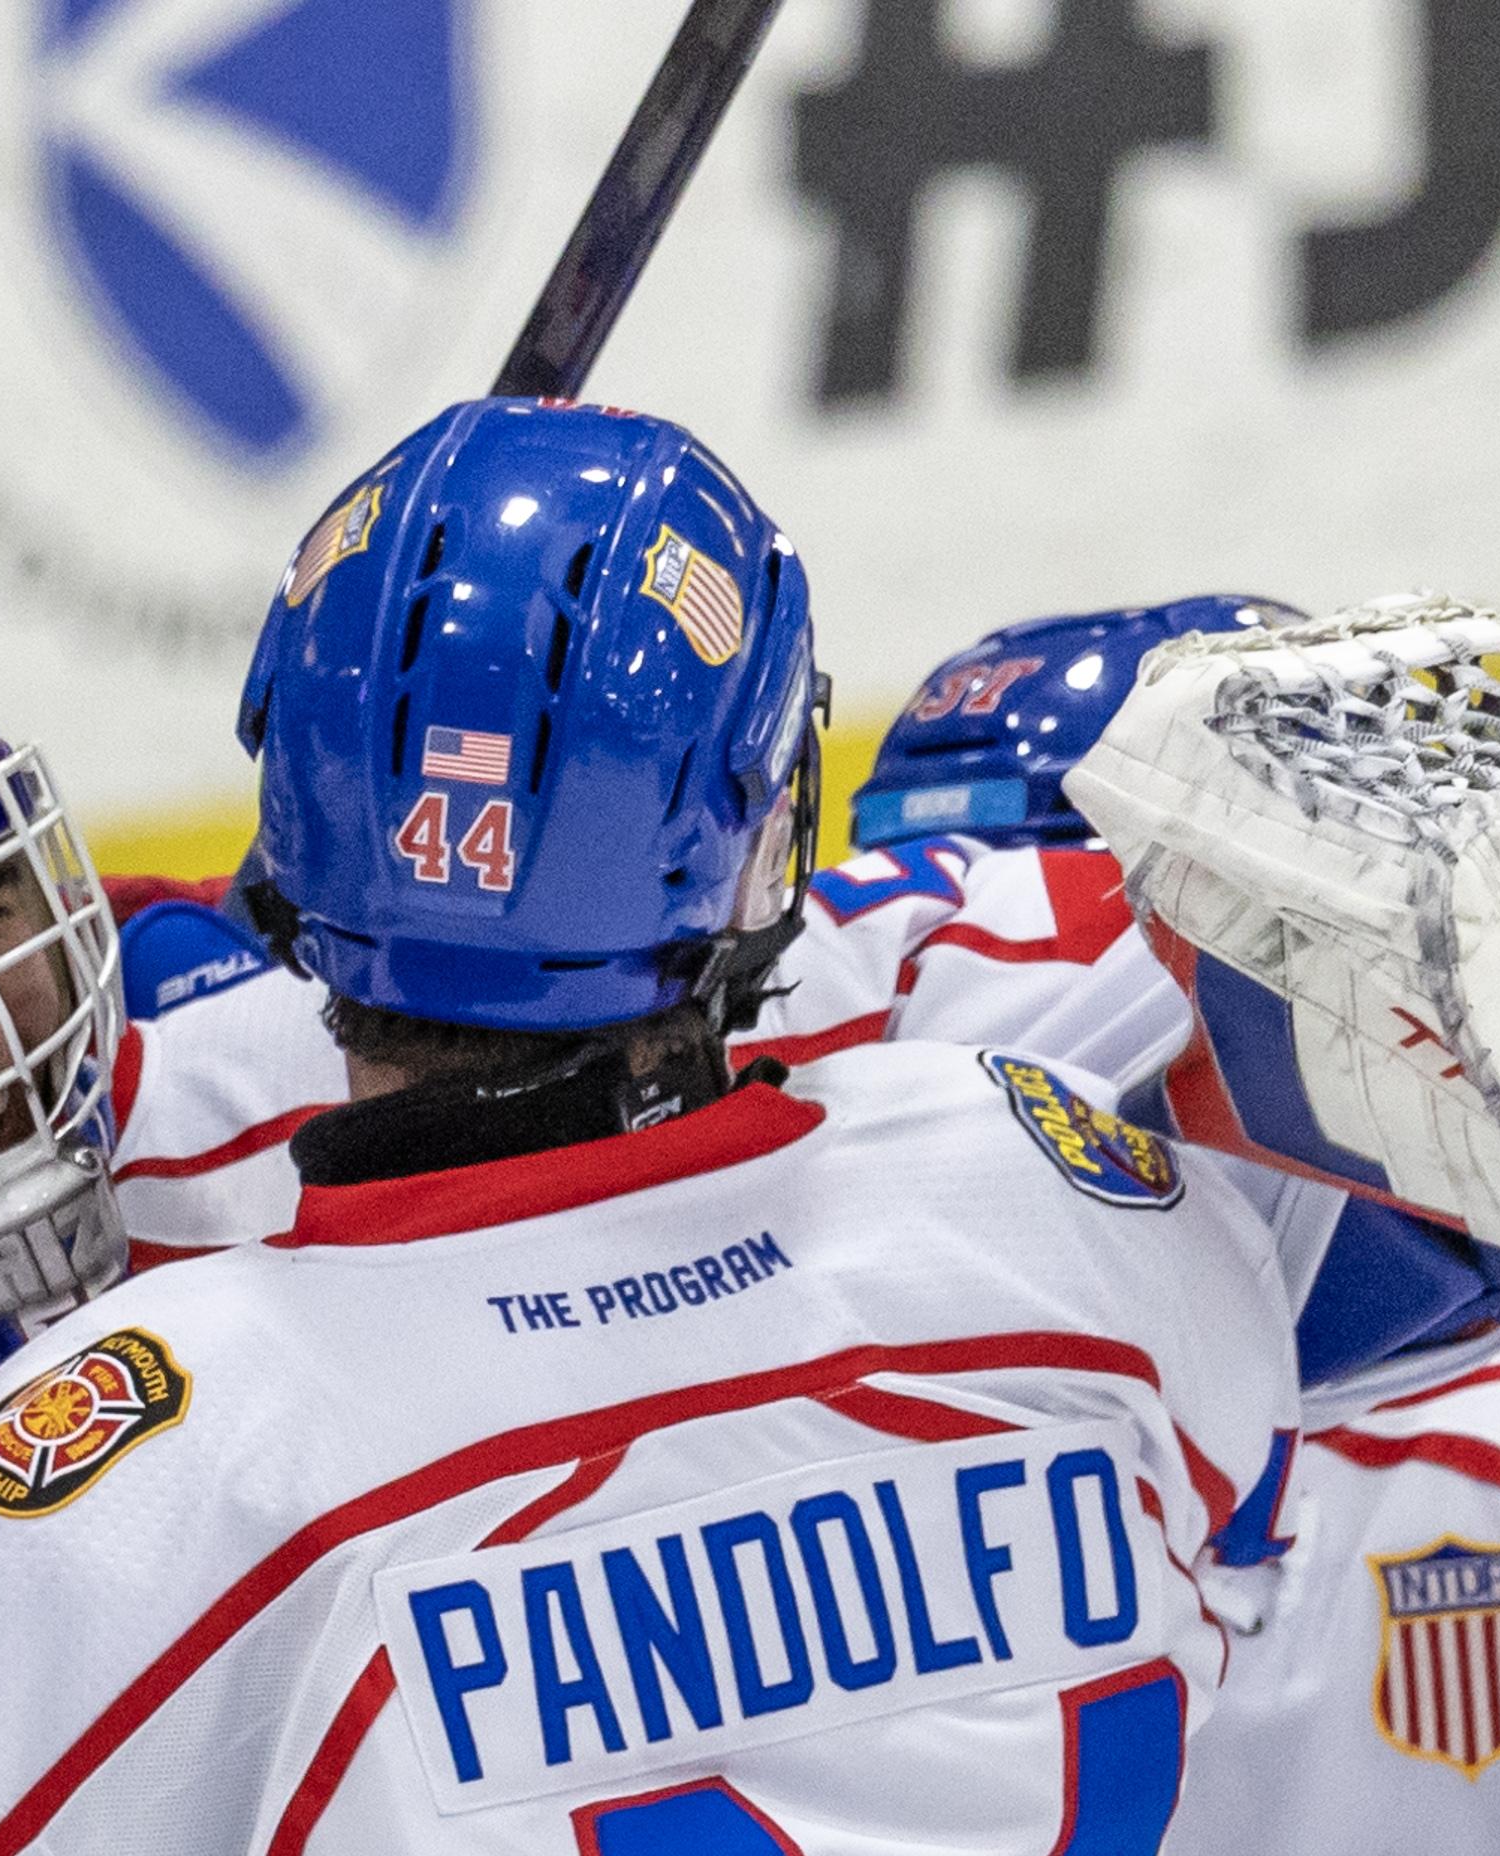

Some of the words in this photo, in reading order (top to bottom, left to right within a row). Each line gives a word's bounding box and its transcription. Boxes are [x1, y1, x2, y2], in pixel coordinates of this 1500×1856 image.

[396, 794, 515, 893] 44
[486, 1292, 581, 1334] THE
[584, 1230, 794, 1326] PROGRAM
[87, 1364, 120, 1395] FIRE
[98, 1336, 170, 1404] YMOUTH
[406, 1446, 1140, 1785] PANDOLFO
